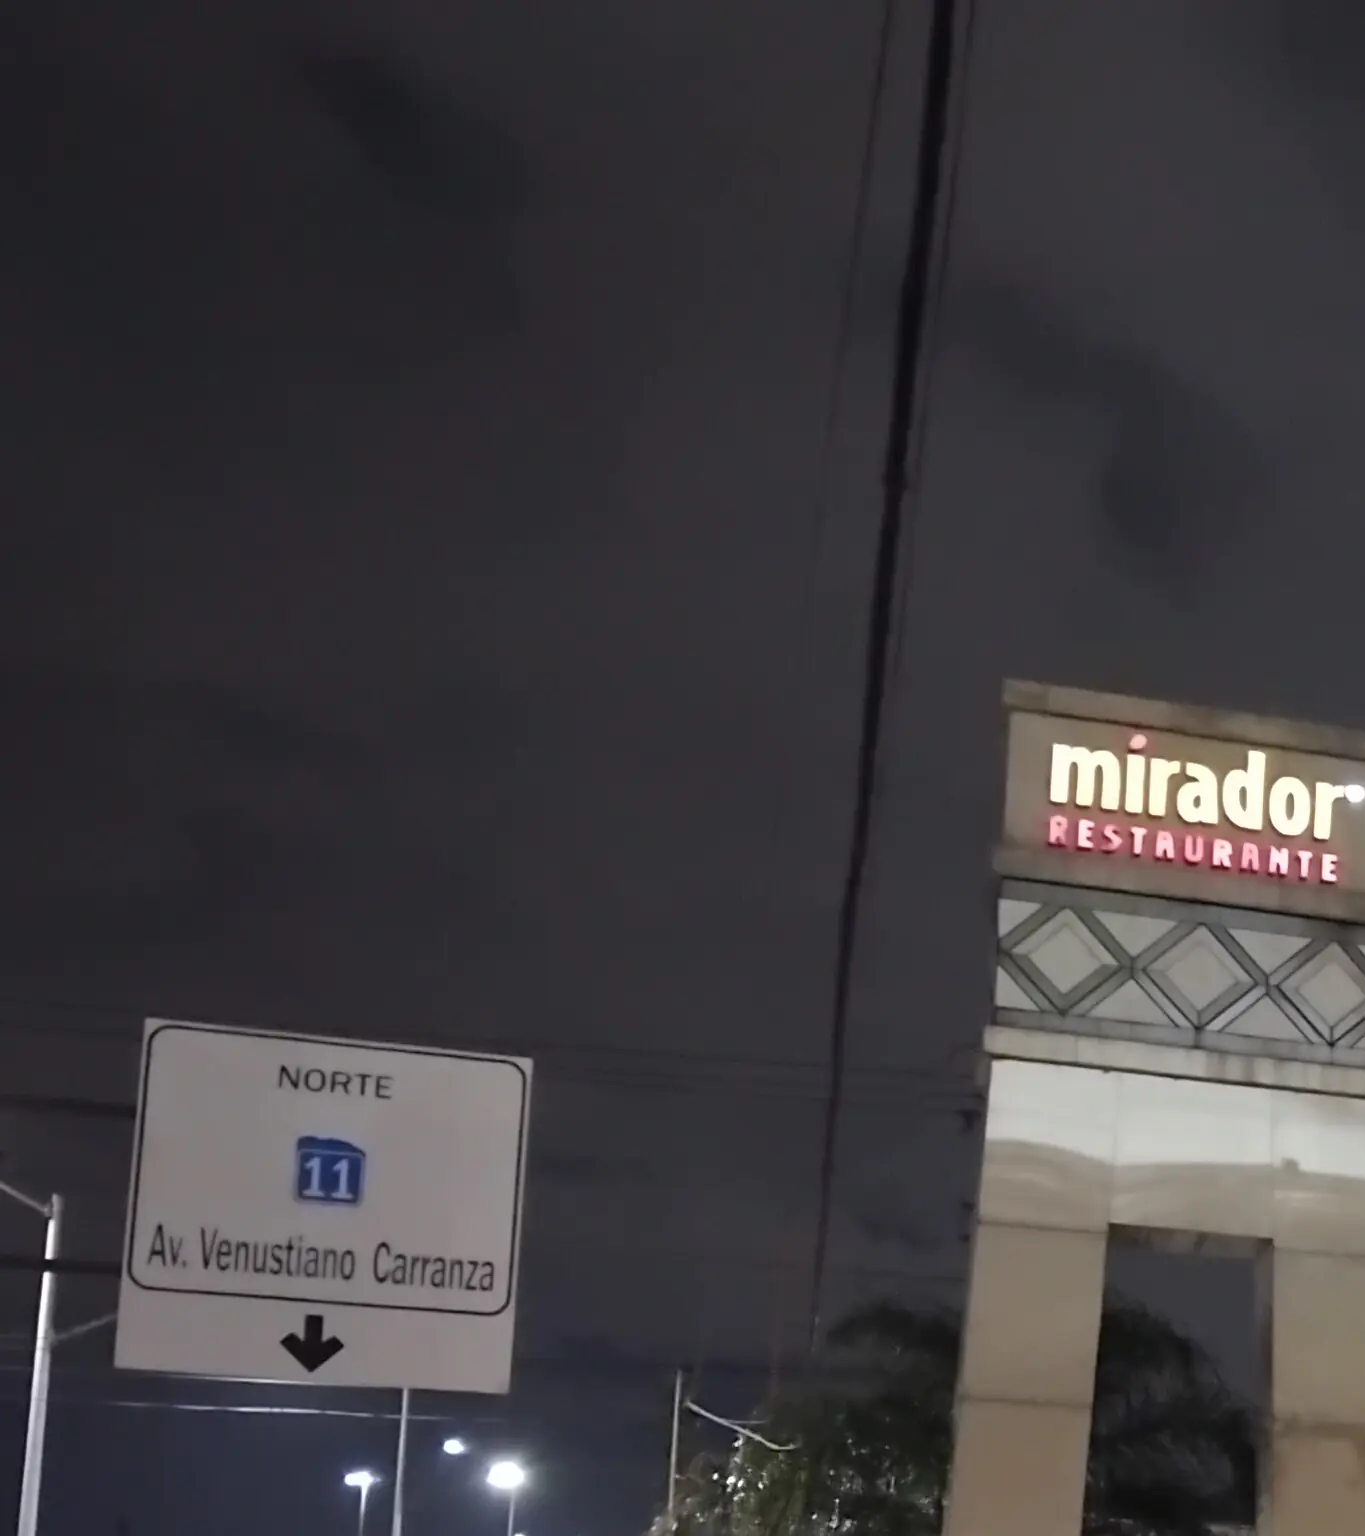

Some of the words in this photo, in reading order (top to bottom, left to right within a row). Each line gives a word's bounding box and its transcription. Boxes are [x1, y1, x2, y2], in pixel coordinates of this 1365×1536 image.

[1048, 733, 1346, 841] mirador
[1047, 815, 1340, 884] RESTAURANTE
[277, 1064, 394, 1100] NORTE
[302, 1156, 353, 1200] 11
[147, 1224, 188, 1269] Av.
[200, 1227, 356, 1282] Venustiano
[372, 1241, 495, 1293] Carranza
